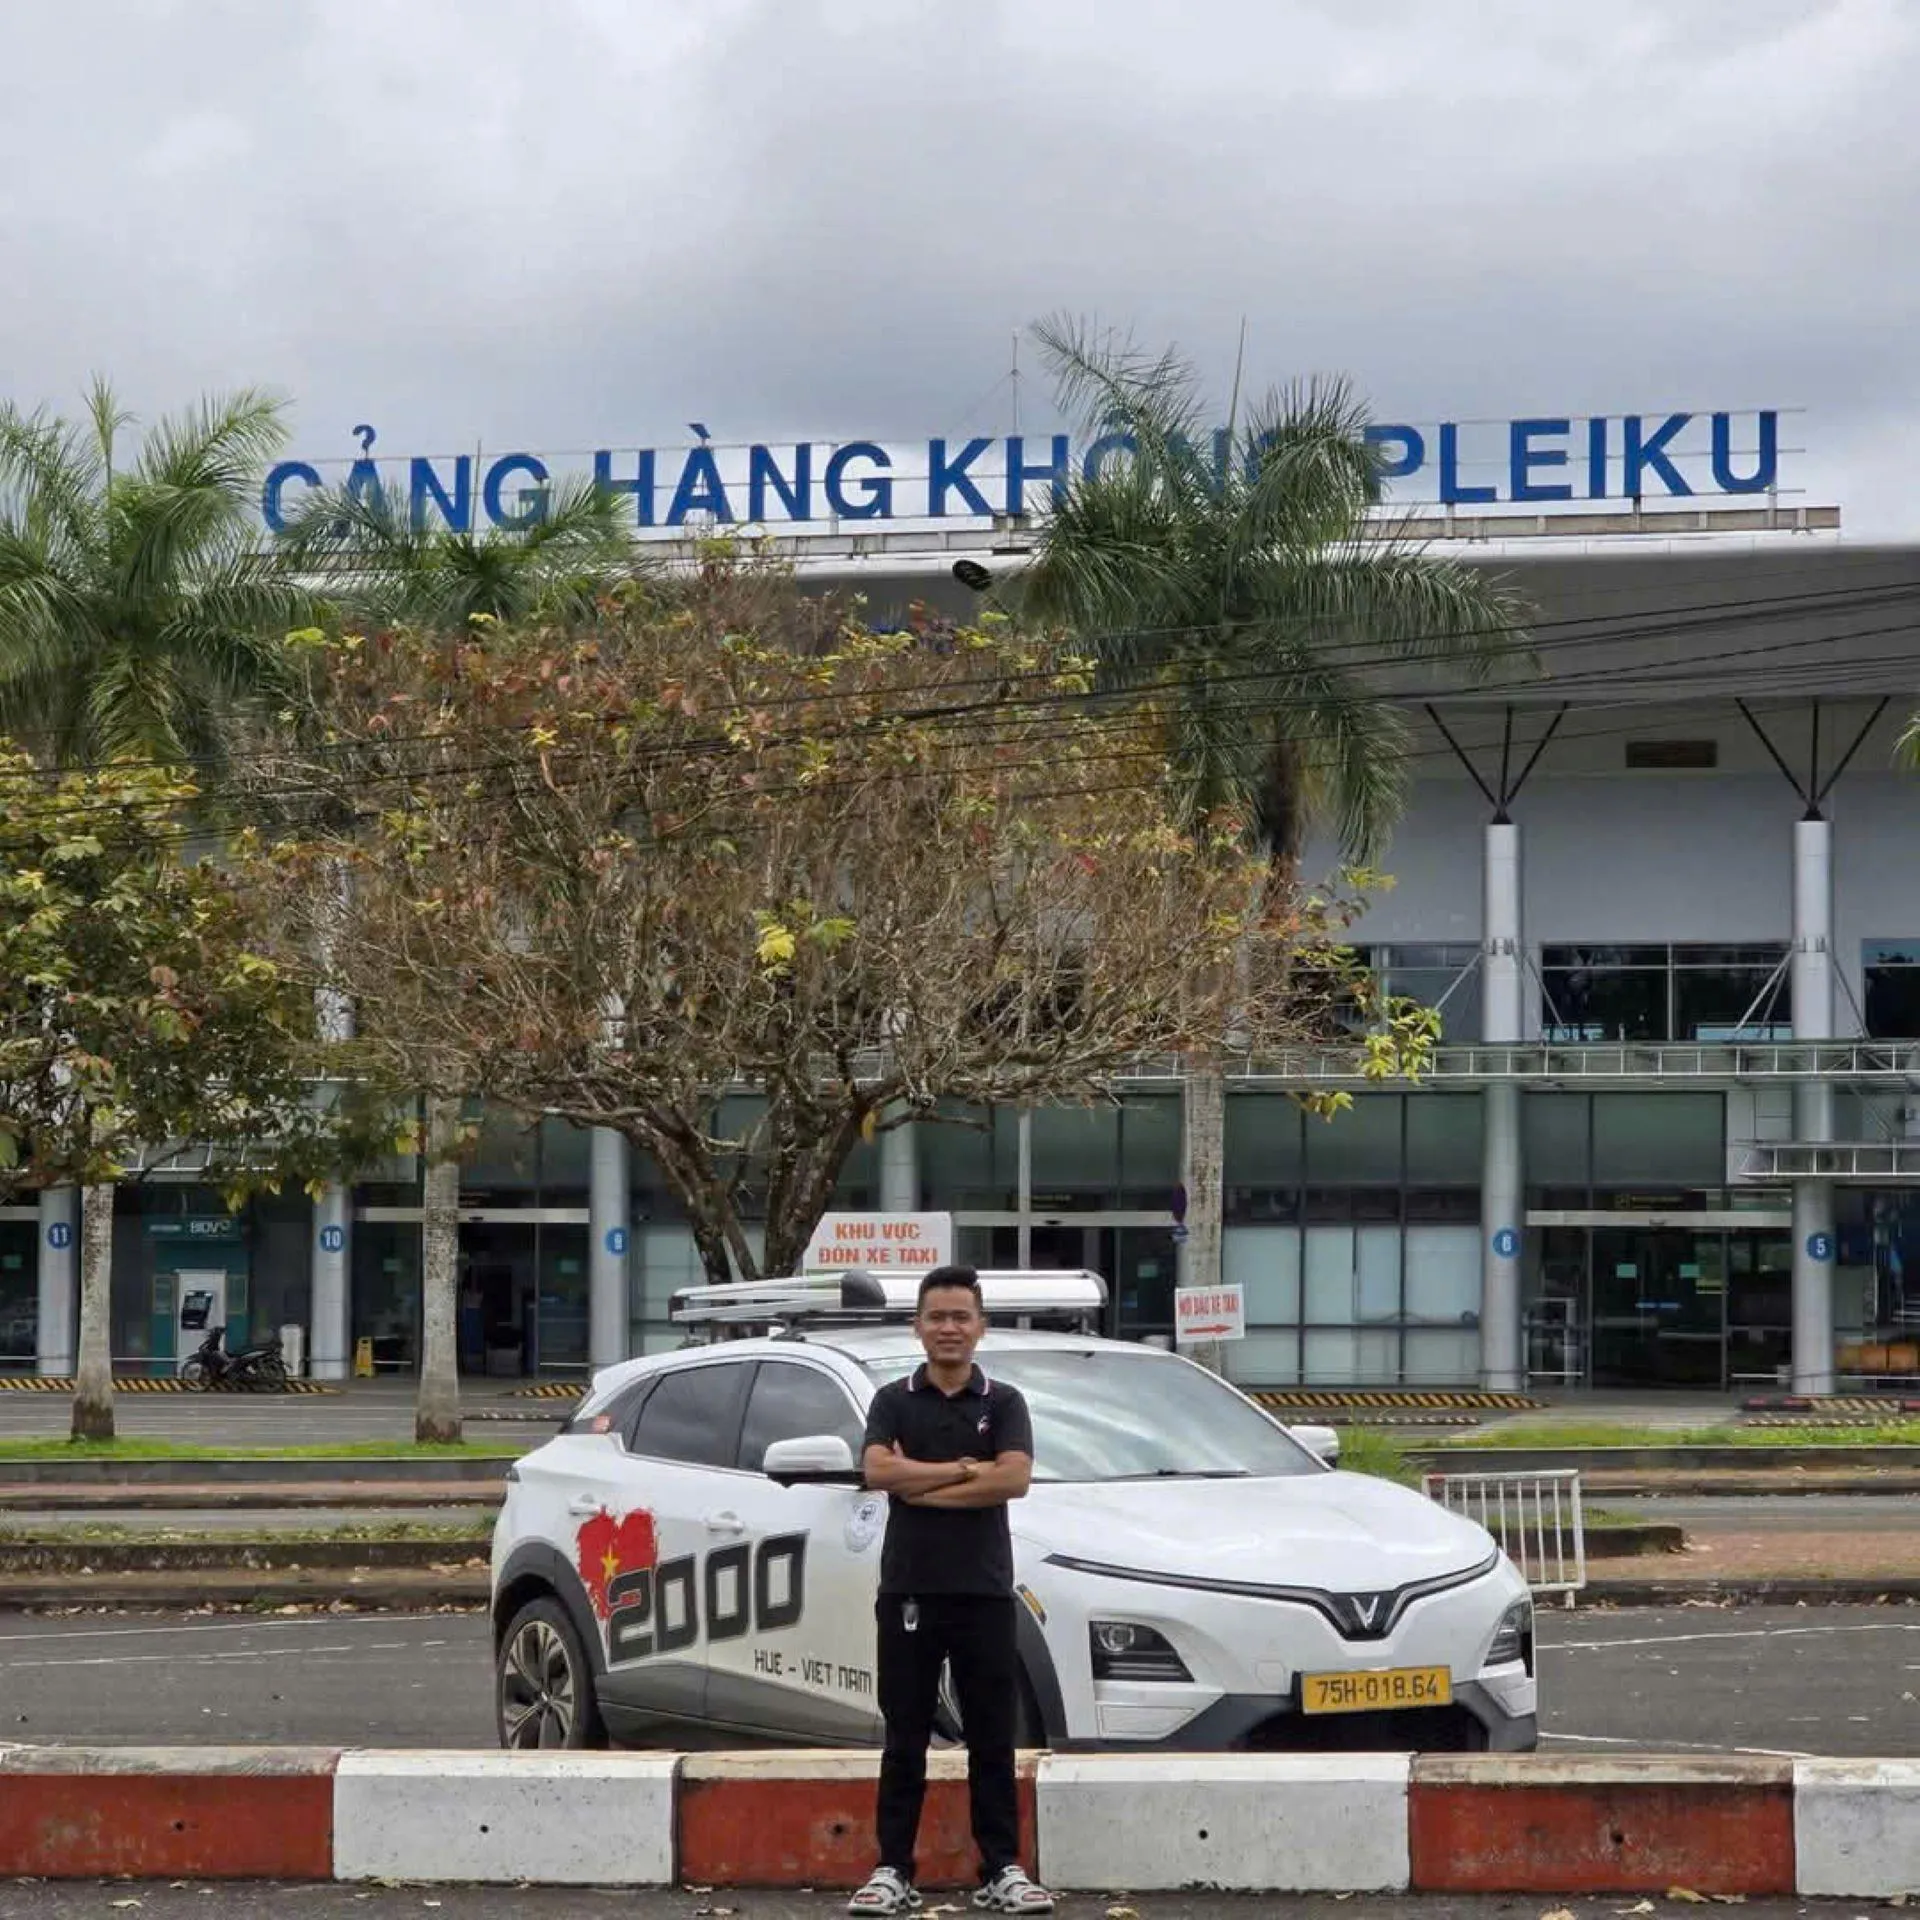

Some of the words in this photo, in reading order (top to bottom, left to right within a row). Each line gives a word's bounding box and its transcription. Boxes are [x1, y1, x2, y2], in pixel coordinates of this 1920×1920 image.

[262, 424, 550, 536] CẢNG
[594, 423, 893, 525] HÀNG
[927, 405, 1318, 518] KHÔN
[1363, 411, 1777, 504] PLEIKU
[52, 1227, 68, 1245] 11
[324, 1230, 341, 1248] 10
[835, 1222, 876, 1240] KHU
[881, 1221, 922, 1242] VỰC
[866, 1247, 891, 1264] XE
[896, 1247, 939, 1264] TAXI
[1815, 1237, 1826, 1256] 5
[607, 1530, 809, 1667] 2000
[754, 1648, 783, 1675] HUE
[801, 1658, 833, 1688] VIET
[838, 1665, 872, 1694] NAM
[1316, 1673, 1437, 1704] 75H-018.64
